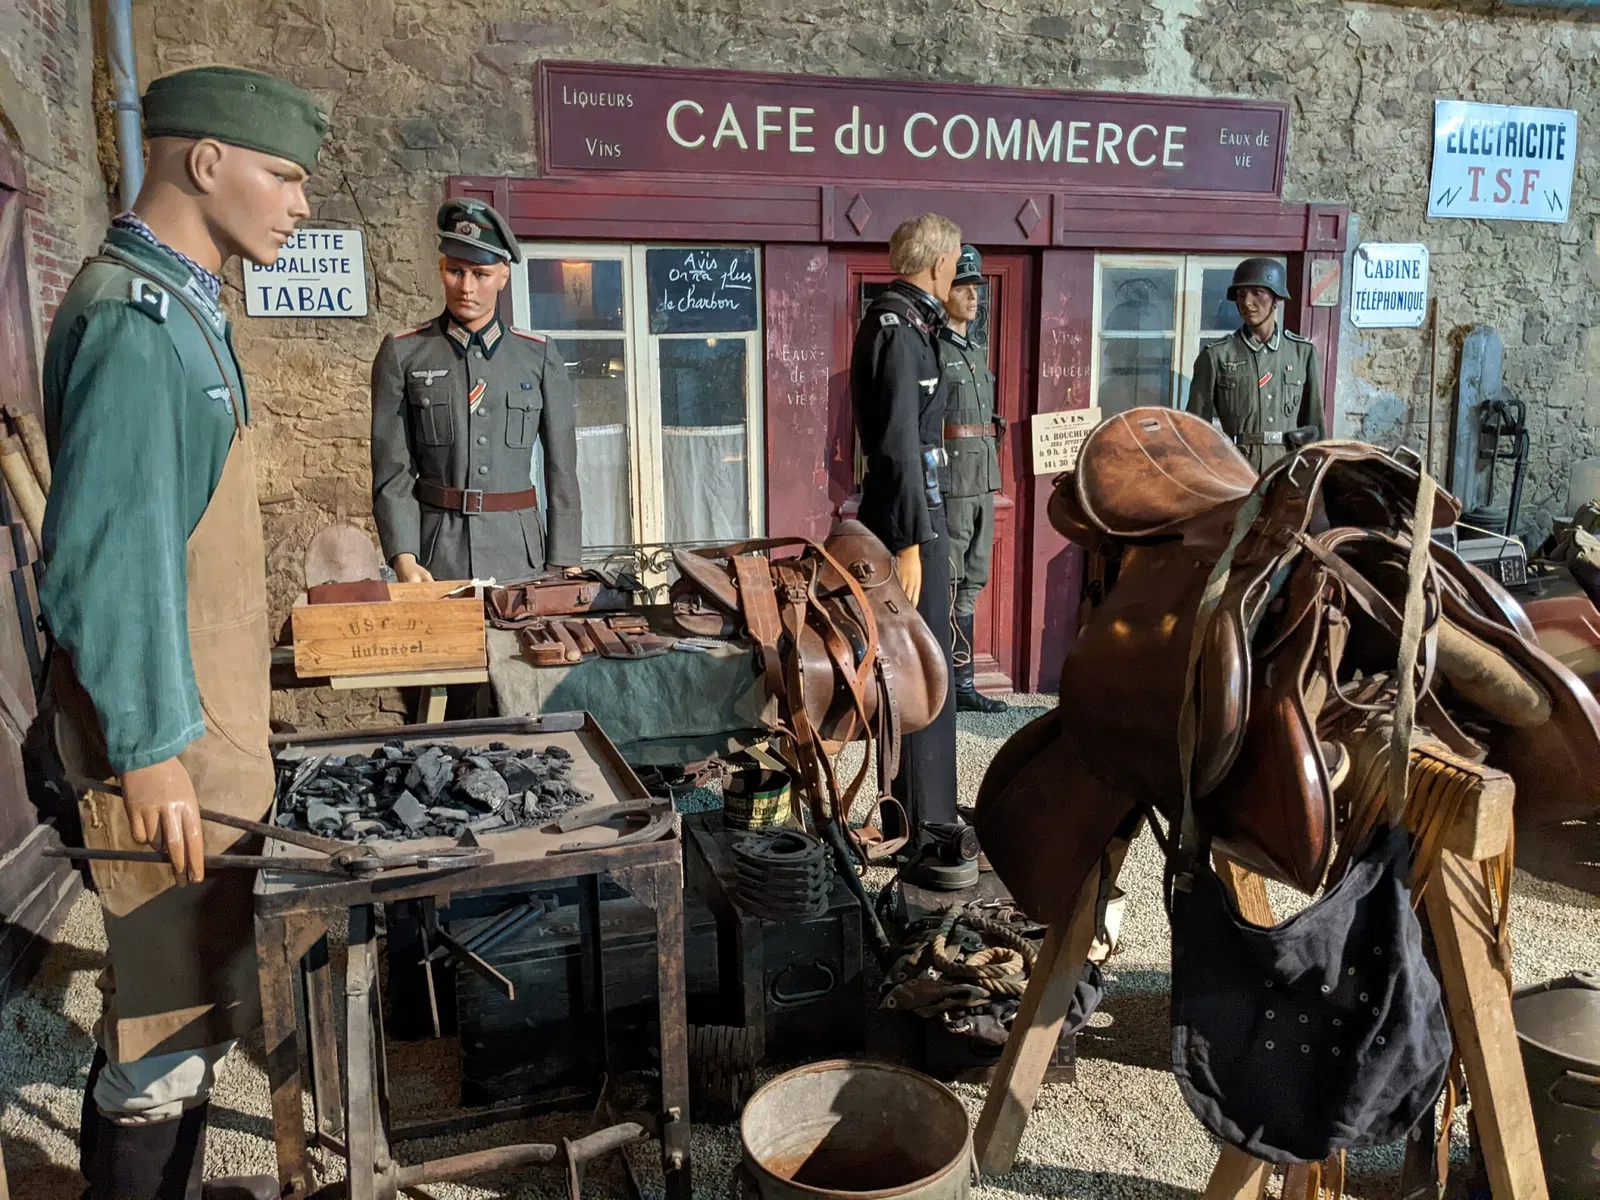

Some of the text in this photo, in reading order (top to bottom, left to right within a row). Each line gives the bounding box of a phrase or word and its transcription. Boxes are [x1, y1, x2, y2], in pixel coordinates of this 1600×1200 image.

[666, 99, 1188, 167] CAFE du COMMERCE
[279, 232, 344, 250] CETTE
[684, 250, 718, 270] Avis
[1364, 259, 1421, 279] CABINE
[720, 258, 753, 290] plus
[257, 286, 354, 312] TABAC
[1356, 287, 1425, 312] TÉLÉPHONIQUE
[1050, 415, 1085, 425] AVIS
[1040, 434, 1050, 443] LA
